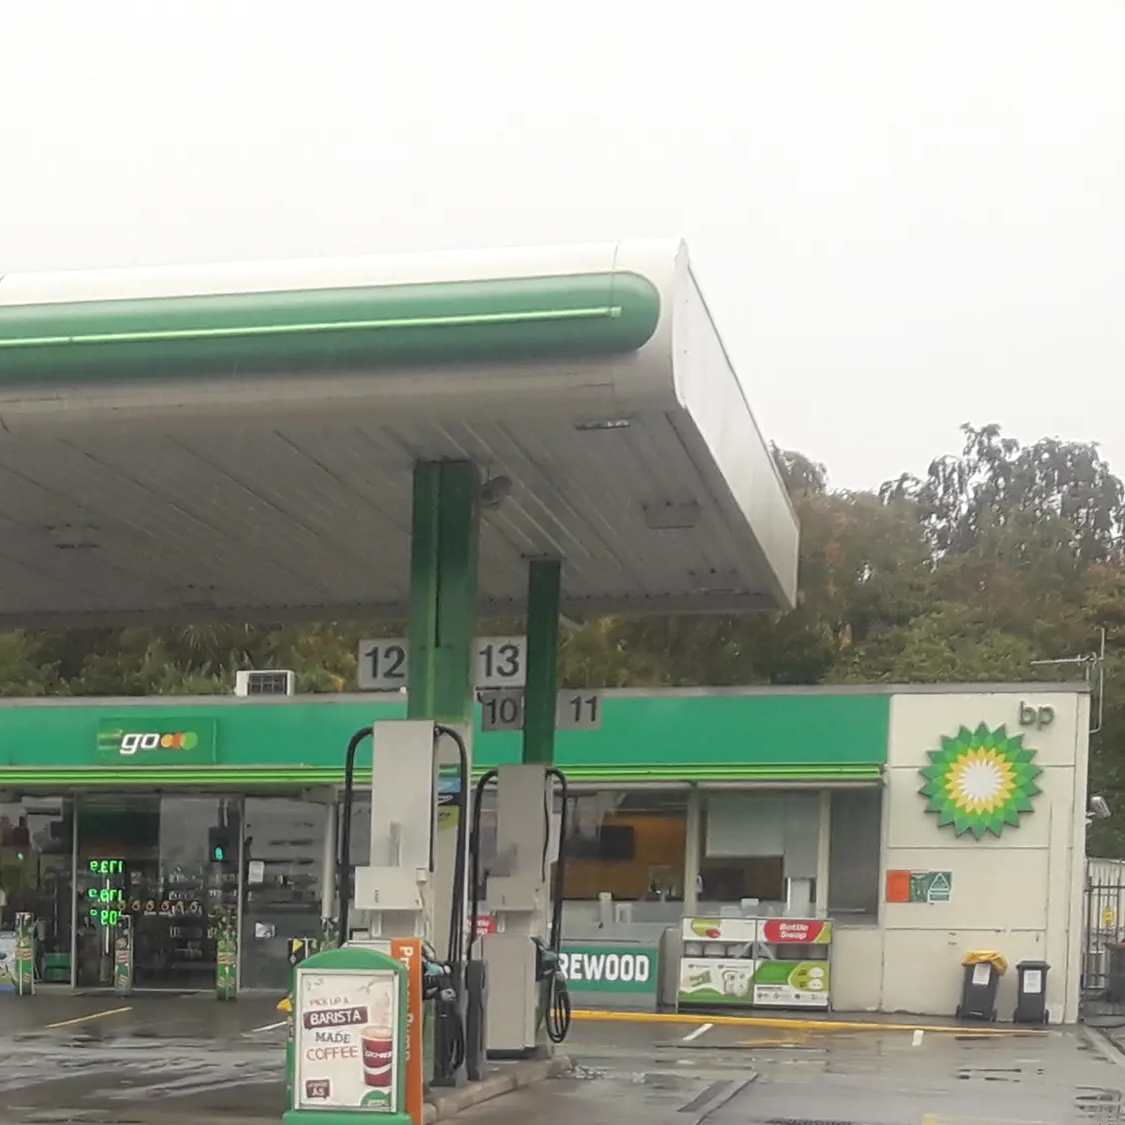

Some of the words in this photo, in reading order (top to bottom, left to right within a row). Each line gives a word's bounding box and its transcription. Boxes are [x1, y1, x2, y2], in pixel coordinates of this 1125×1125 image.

[364, 645, 406, 679] 12
[479, 643, 520, 678] 13
[486, 696, 517, 725] 10
[570, 696, 598, 723] 11
[1019, 700, 1054, 731] bp
[119, 733, 160, 755] go
[310, 1009, 362, 1025] BARISTA
[315, 1032, 351, 1044] MADE
[306, 1045, 359, 1062] COFFEE
